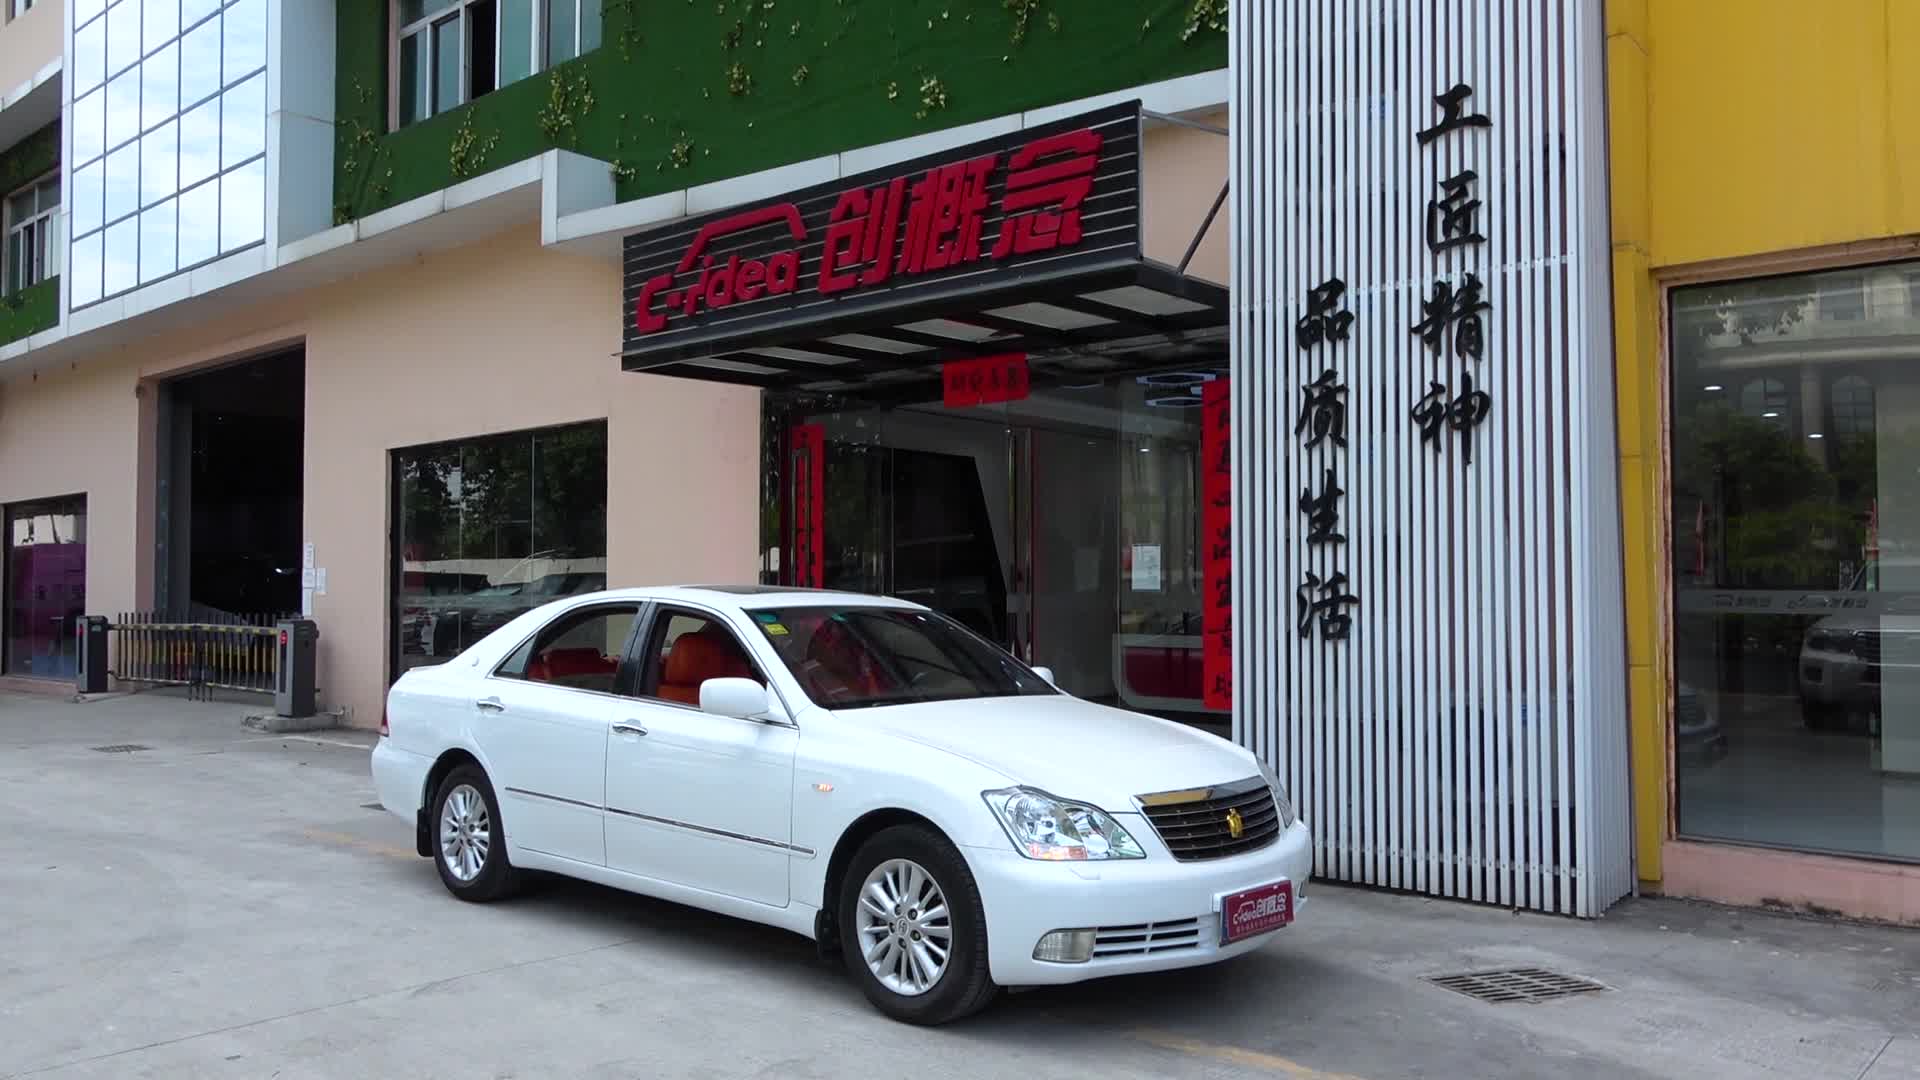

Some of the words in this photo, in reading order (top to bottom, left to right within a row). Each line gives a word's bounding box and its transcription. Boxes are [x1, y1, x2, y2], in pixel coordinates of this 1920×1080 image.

[817, 128, 1103, 294] 创概念
[1411, 83, 1492, 466] 工匠精神
[1295, 277, 1359, 642] 品质生活
